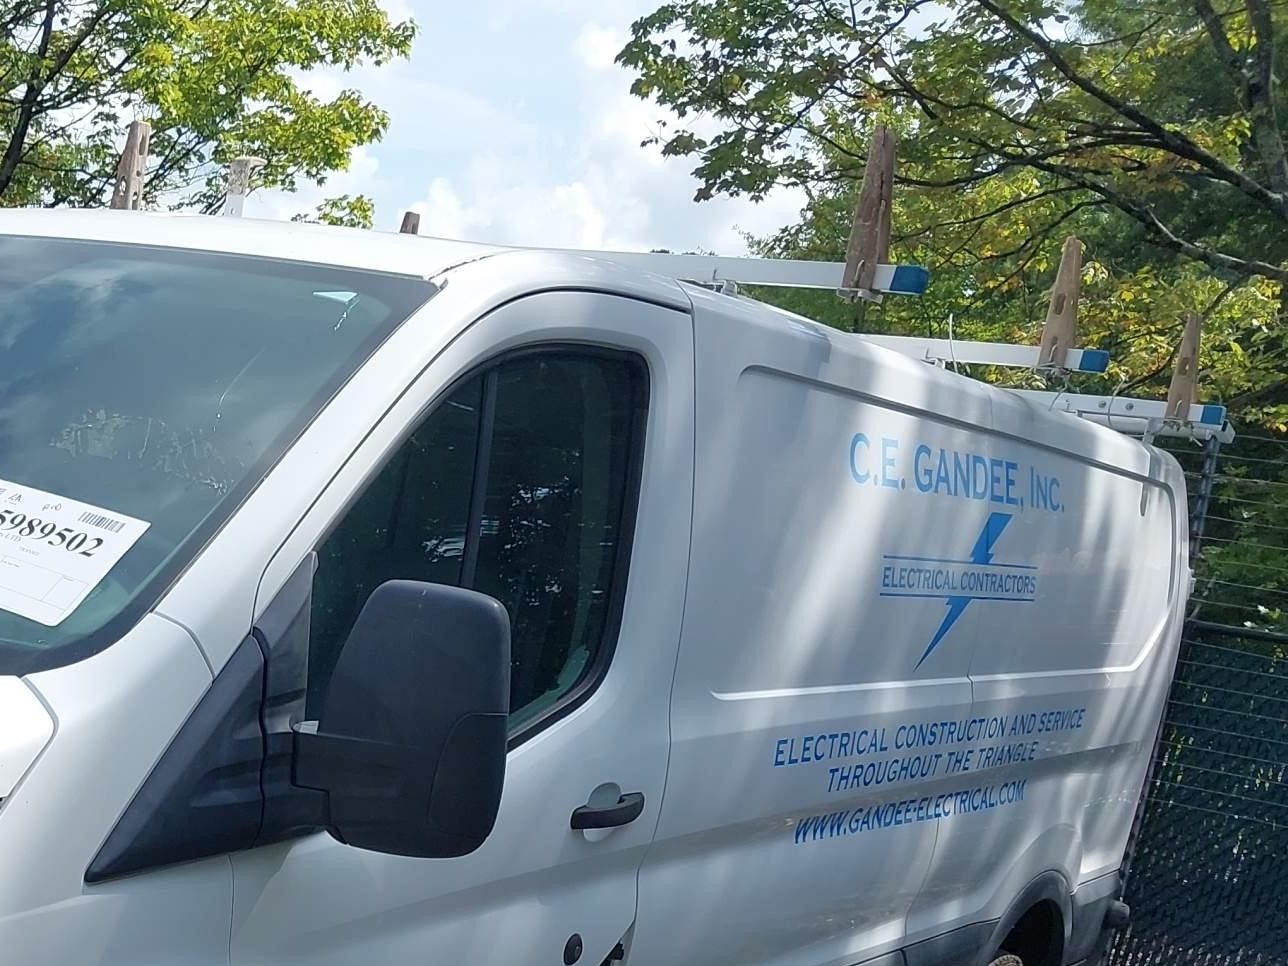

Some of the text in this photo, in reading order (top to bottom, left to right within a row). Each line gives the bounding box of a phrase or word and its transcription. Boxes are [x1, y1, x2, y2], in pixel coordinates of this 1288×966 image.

[849, 432, 906, 490] C.E.
[914, 444, 1024, 512] GANDEE,
[882, 566, 1037, 594] ELECTRICAL CONTRACTORS
[774, 709, 1086, 766] ELECTRICAL CONSTRUCTION AND SERVICE
[828, 741, 1039, 792] THROUGHOUT THE TRIANGLE
[795, 779, 1027, 844] WWW.GANDEE-ELECTRICAL.COM
